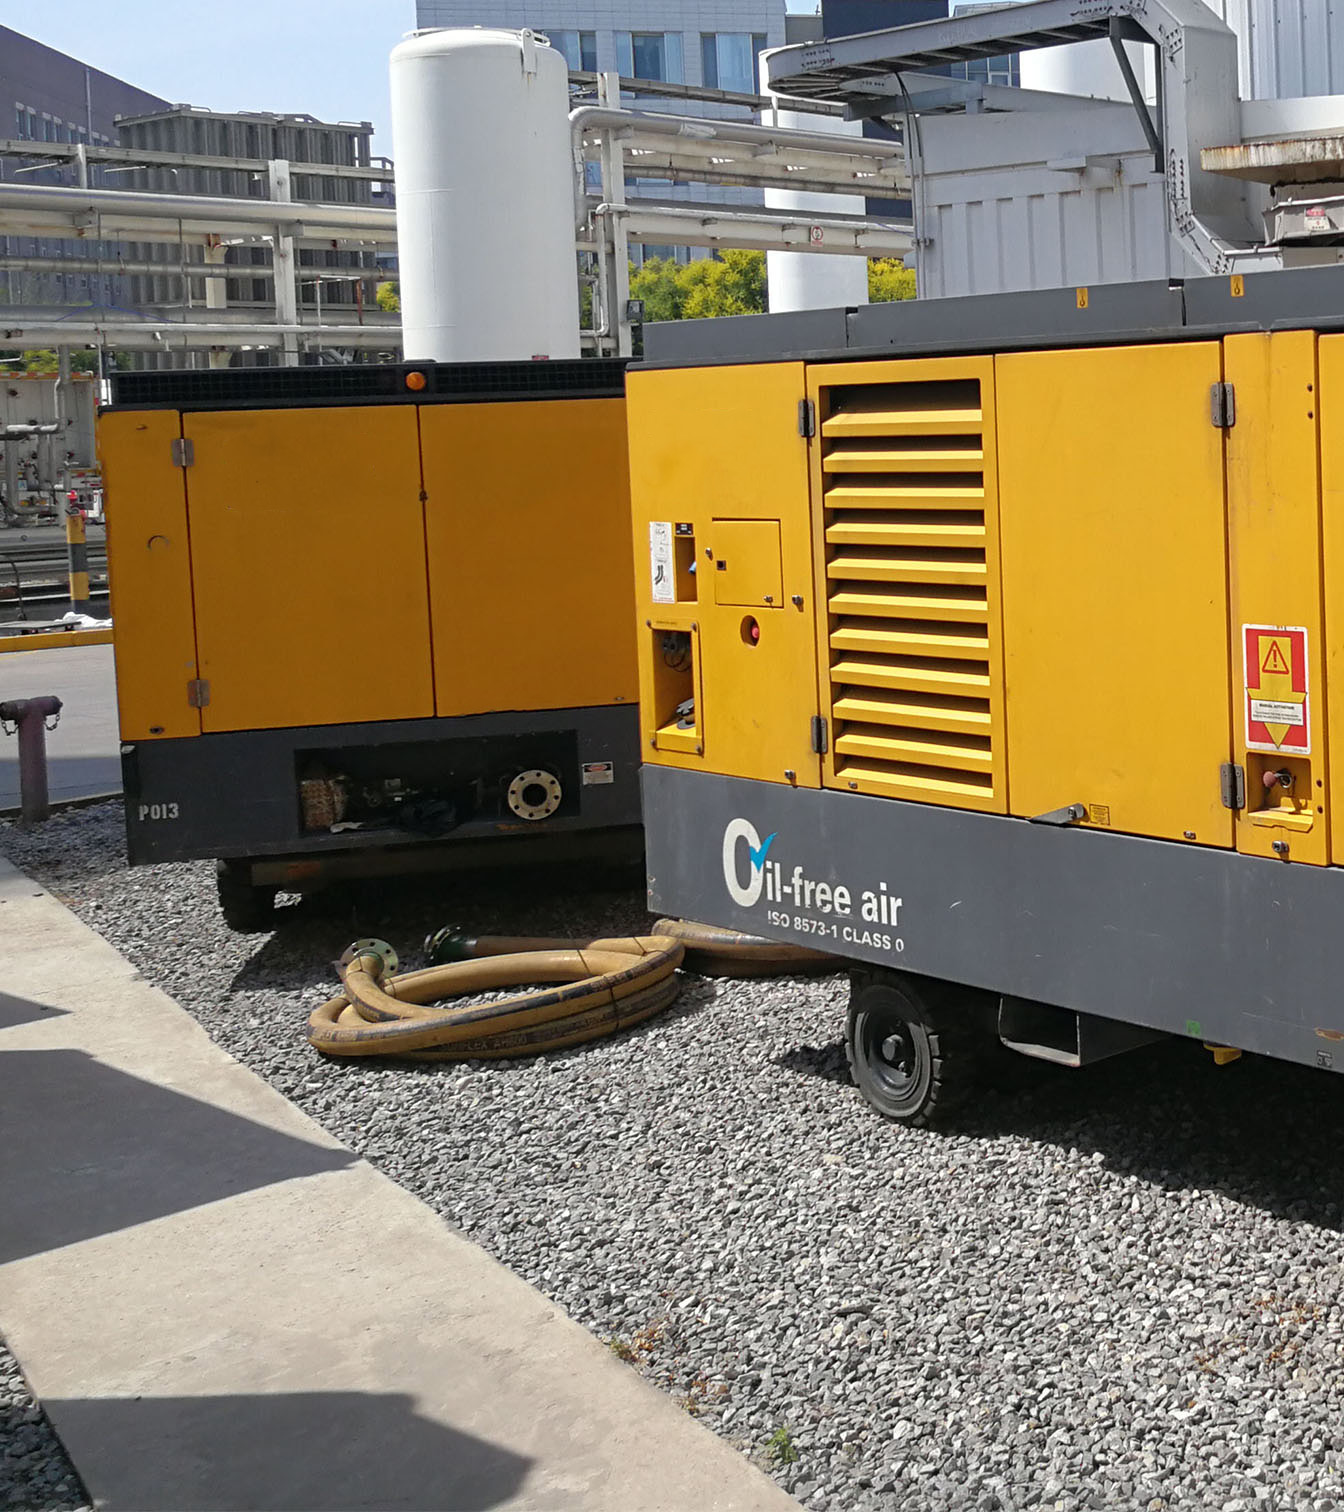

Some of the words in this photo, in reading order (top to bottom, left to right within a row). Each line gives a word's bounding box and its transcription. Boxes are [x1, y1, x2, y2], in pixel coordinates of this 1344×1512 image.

[139, 803, 178, 820] P013
[723, 818, 852, 914] Oil-free
[862, 882, 902, 926] air
[768, 911, 790, 928] ISO
[794, 917, 837, 938] 8573-1
[843, 927, 890, 950] CLASS
[895, 938, 904, 952] 0
